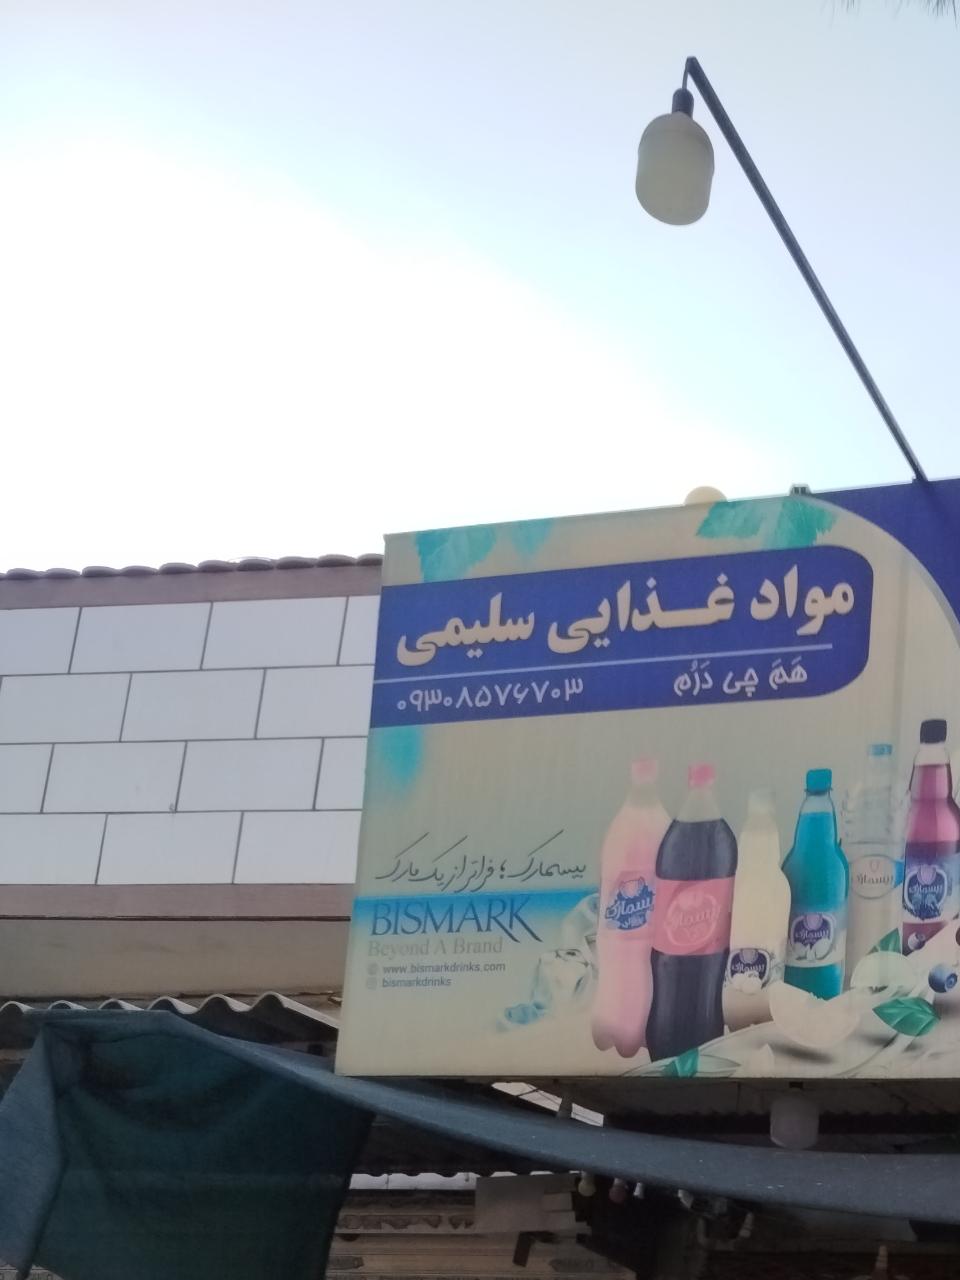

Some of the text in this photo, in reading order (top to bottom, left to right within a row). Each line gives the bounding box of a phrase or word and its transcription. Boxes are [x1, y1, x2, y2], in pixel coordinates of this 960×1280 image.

[397, 564, 855, 667] مواد غذایی سلیمی
[396, 677, 584, 712] ۰۹۳۰۸۵۷۶۷۰۳
[371, 894, 543, 943] BISMARK
[367, 936, 504, 960] Beyond A Brand
[382, 976, 452, 988] bismarkdrinks
